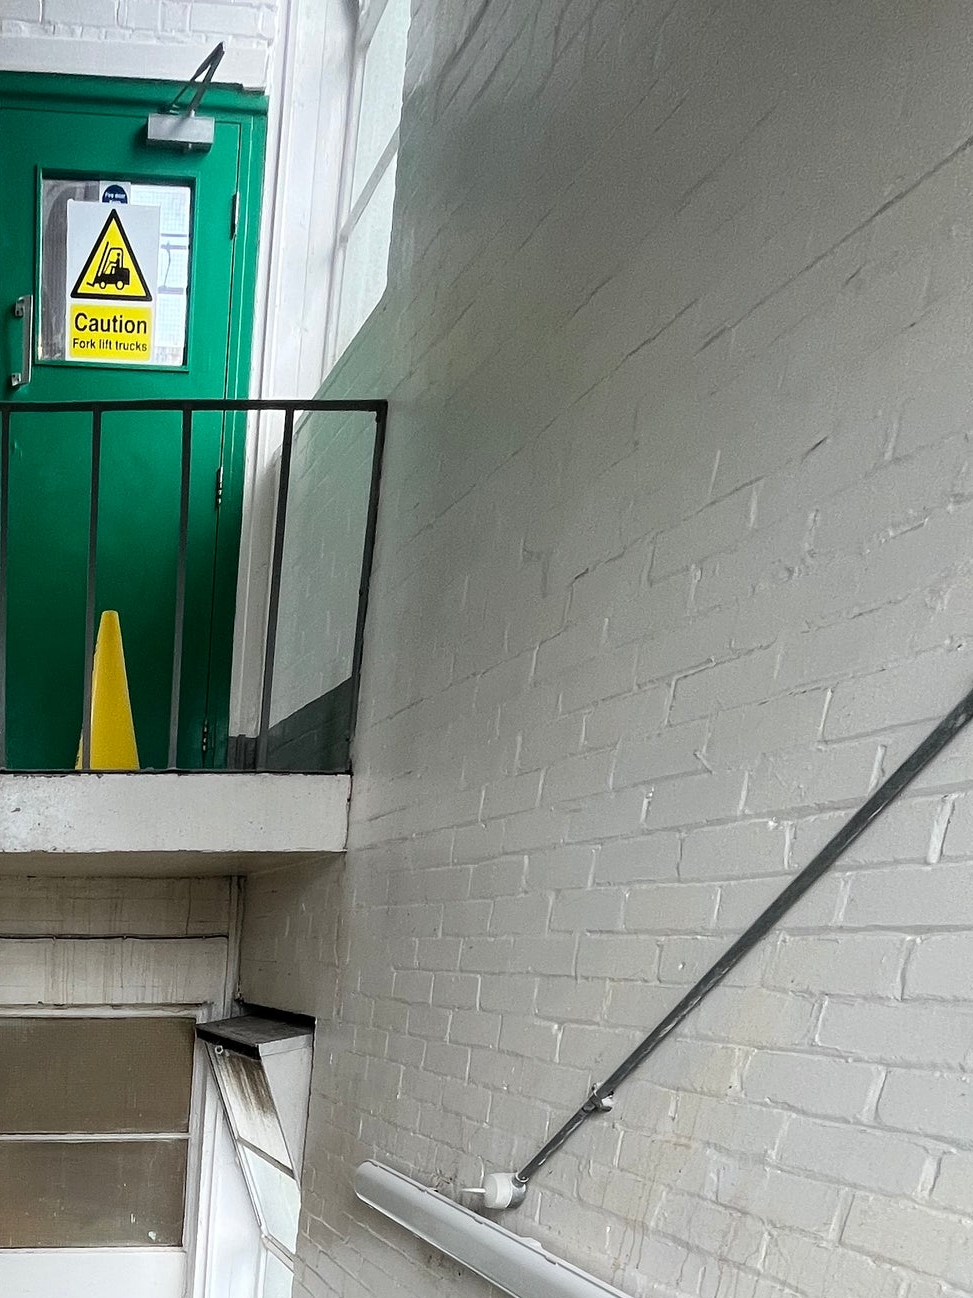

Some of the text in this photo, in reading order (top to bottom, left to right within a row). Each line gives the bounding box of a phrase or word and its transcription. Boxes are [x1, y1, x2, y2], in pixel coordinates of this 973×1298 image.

[74, 312, 147, 334] Caution
[72, 338, 147, 352] Fork lift trucks
